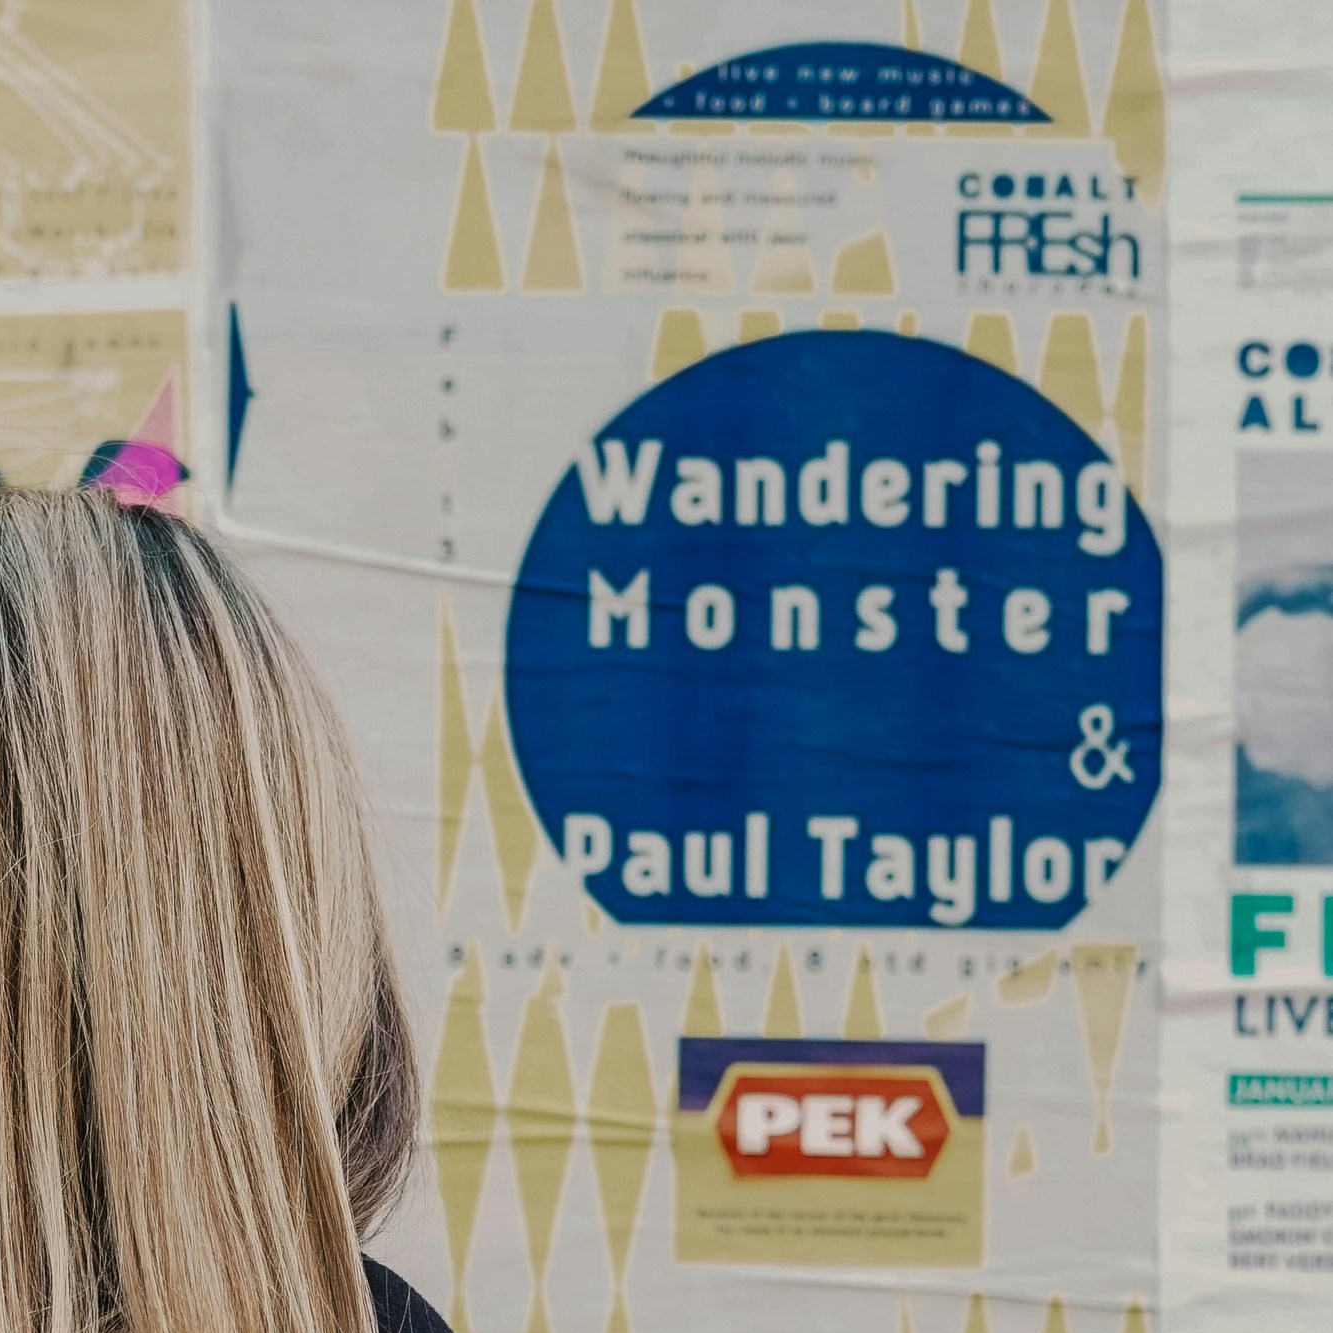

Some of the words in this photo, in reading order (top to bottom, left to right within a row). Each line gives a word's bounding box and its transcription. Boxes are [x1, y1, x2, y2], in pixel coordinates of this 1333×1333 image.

[695, 91, 767, 113] food
[819, 92, 914, 115] board
[929, 97, 1032, 119] games
[718, 62, 780, 82] live
[797, 64, 861, 83] new
[878, 65, 974, 86] music
[575, 438, 1129, 557] Wandering
[587, 567, 1131, 656] Monster
[1070, 702, 1135, 790] &
[562, 811, 770, 900] Paul
[807, 814, 1131, 927] Taylor
[734, 1092, 927, 1160] PEK
